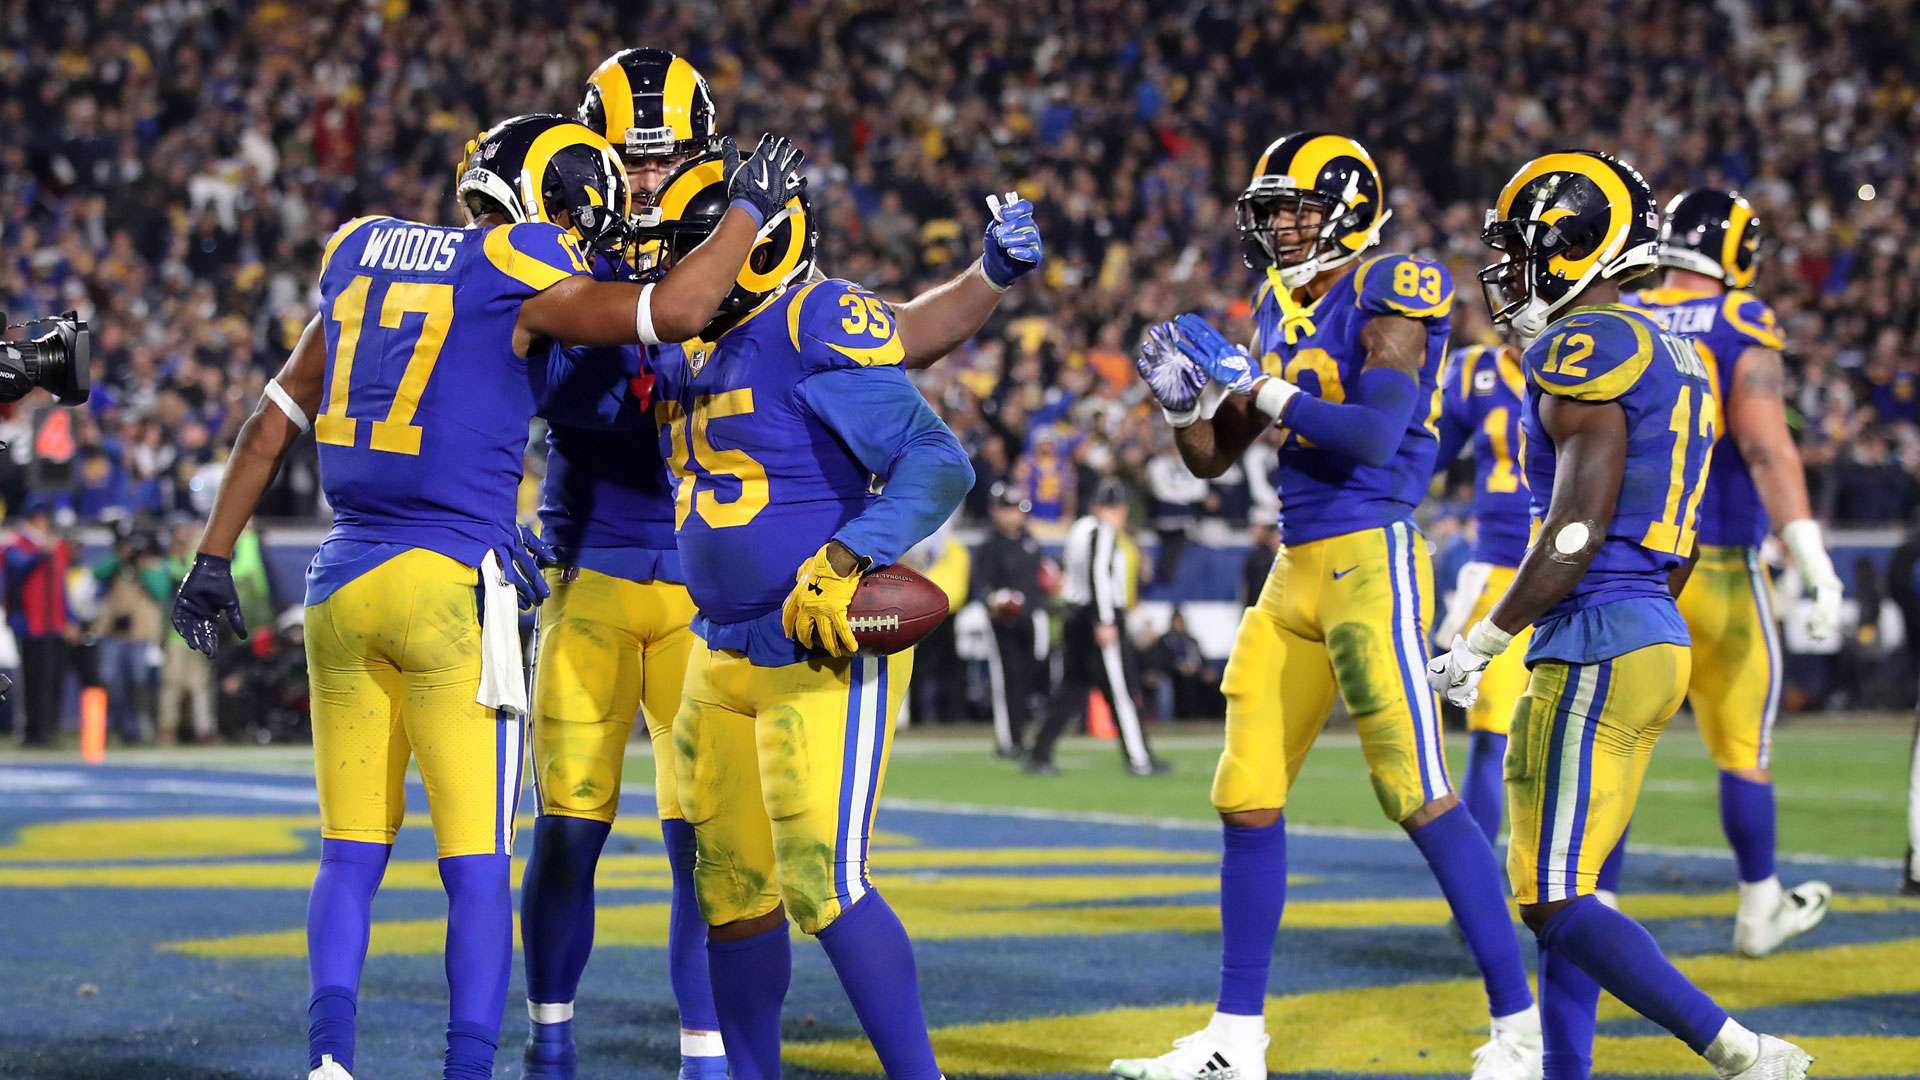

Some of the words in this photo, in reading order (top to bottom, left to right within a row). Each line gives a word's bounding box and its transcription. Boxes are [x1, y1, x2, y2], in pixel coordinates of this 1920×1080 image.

[359, 227, 464, 272] WOODS
[1393, 261, 1442, 305] 83
[839, 294, 890, 339] 35
[314, 275, 455, 456] 17
[1541, 333, 1596, 378] 12
